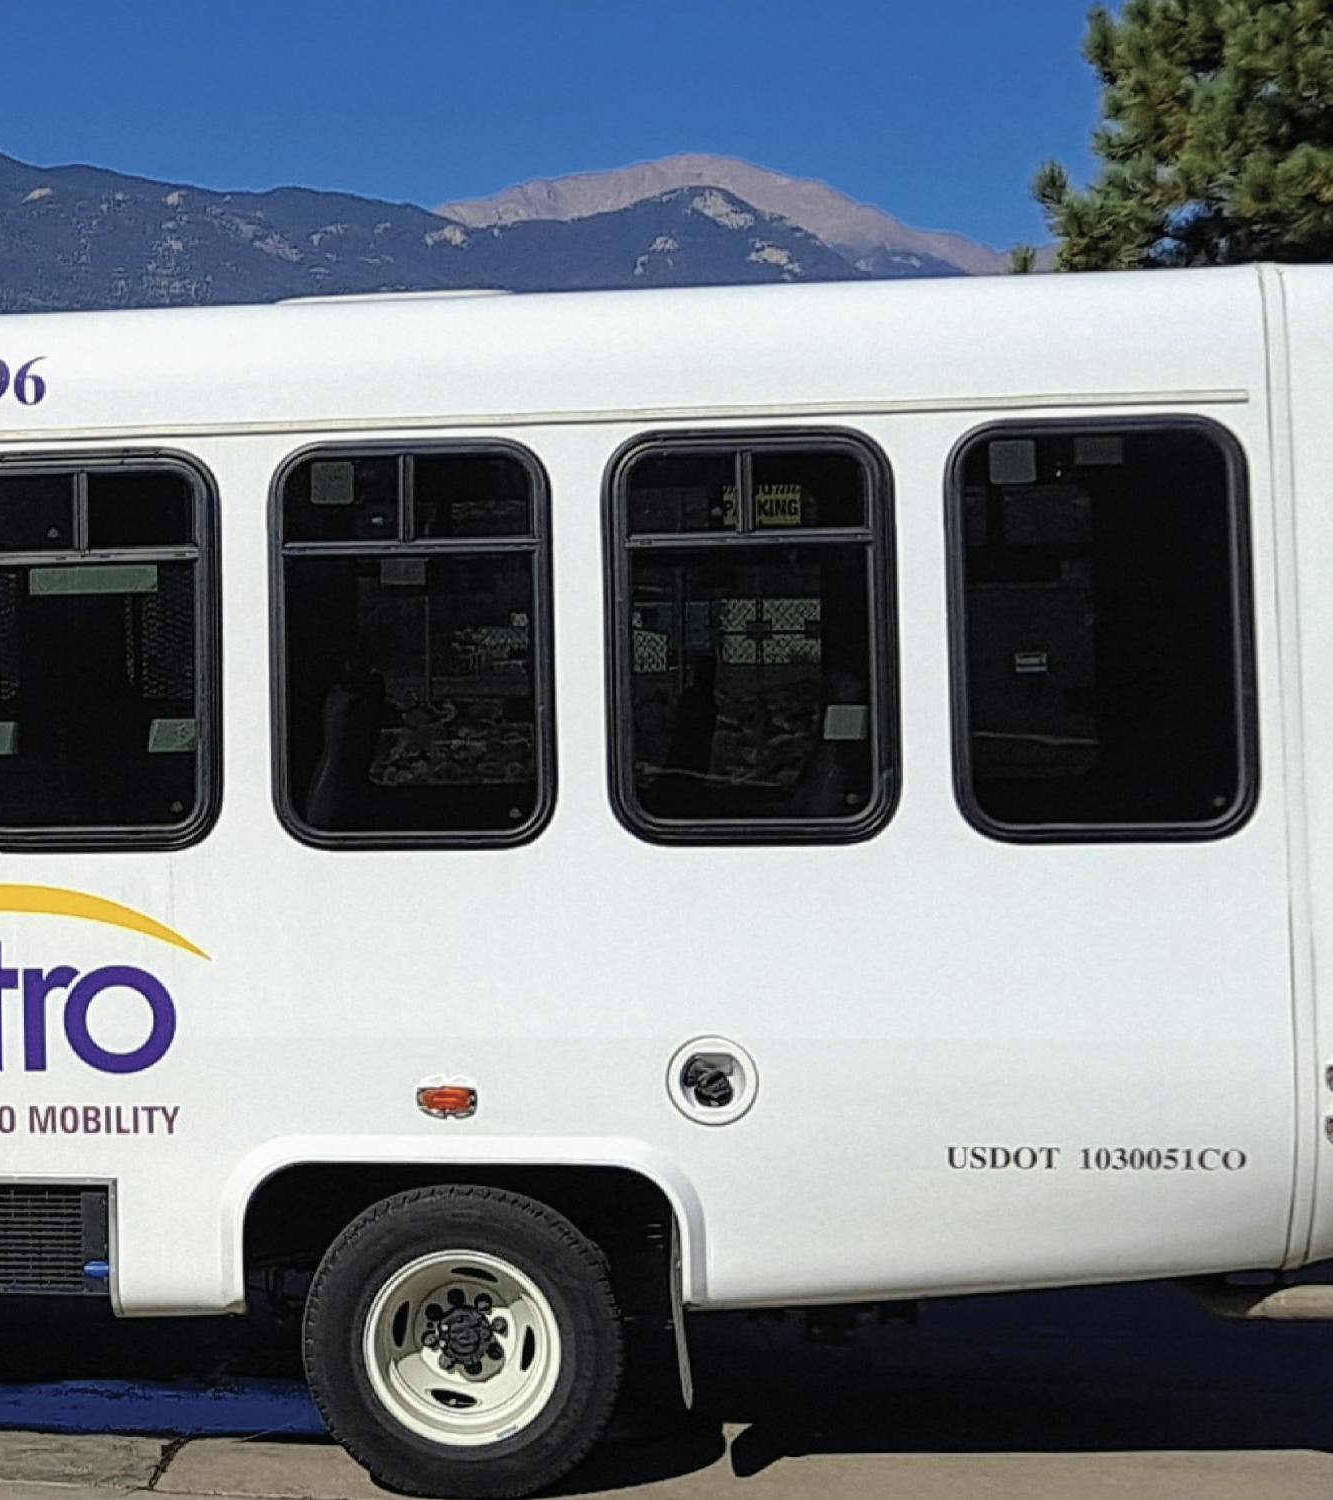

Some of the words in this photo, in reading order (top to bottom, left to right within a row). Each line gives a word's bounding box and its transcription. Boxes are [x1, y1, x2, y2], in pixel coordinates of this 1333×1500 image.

[29, 1105, 180, 1134] MOBILITY
[946, 1146, 1061, 1170] USDOT
[1080, 1147, 1248, 1171] 1030051CO
